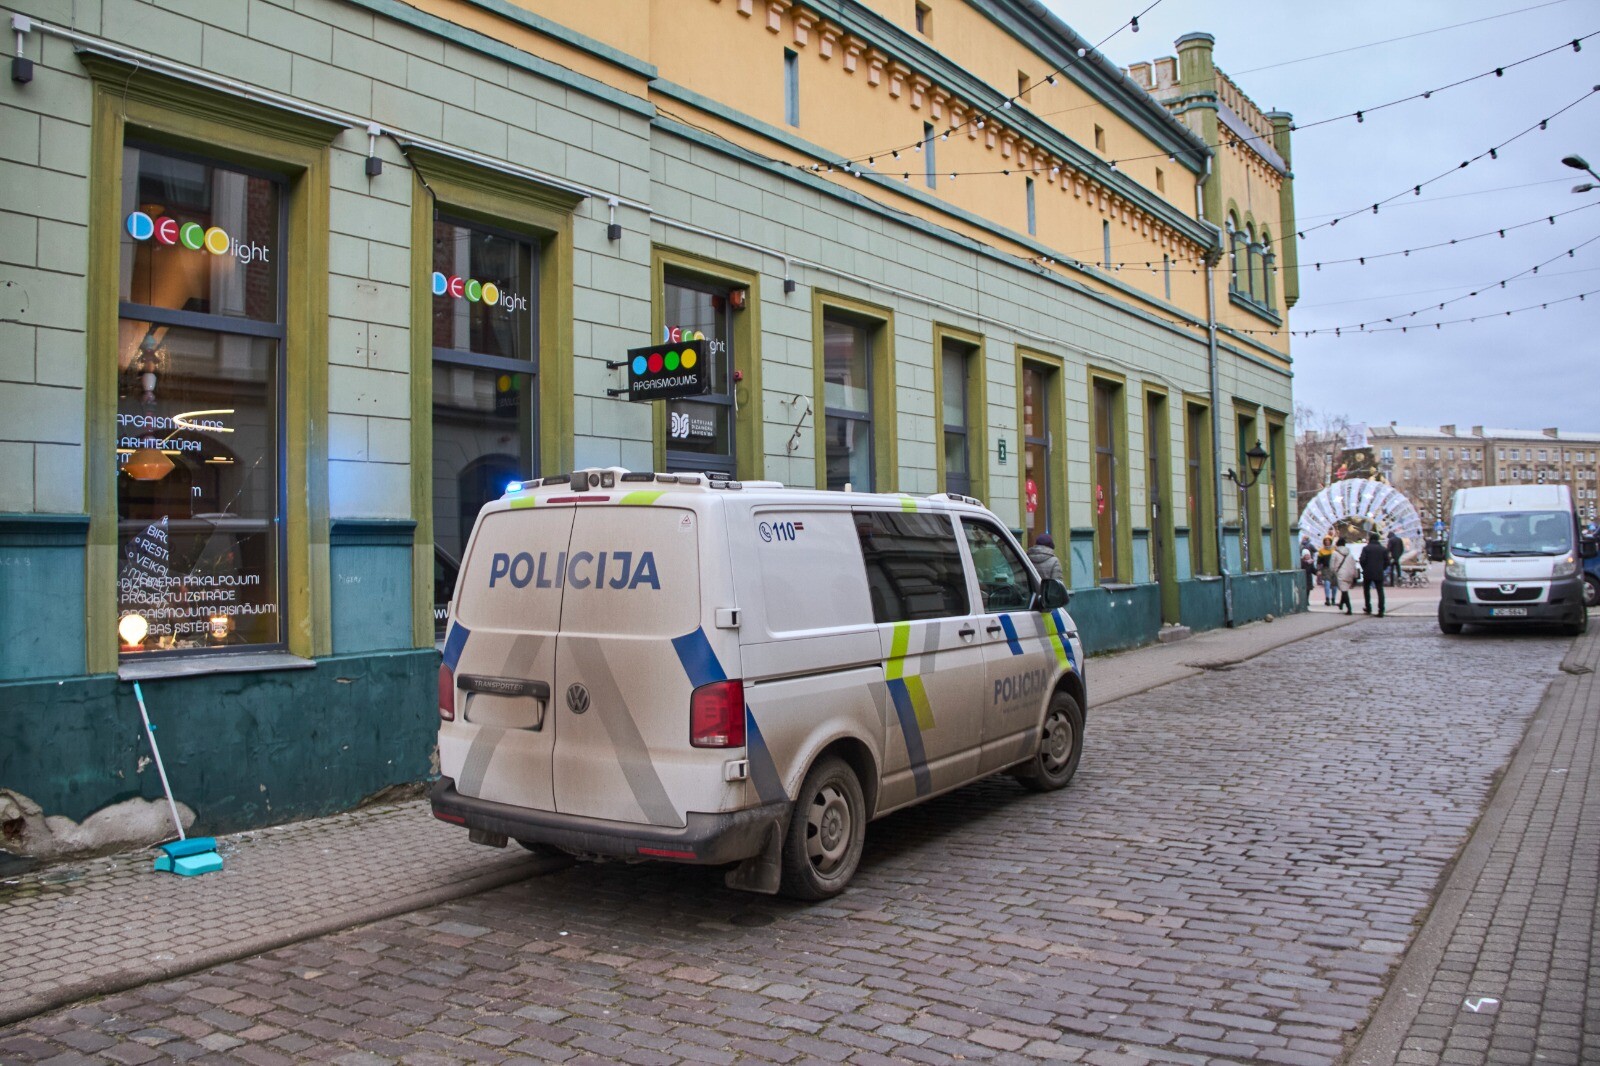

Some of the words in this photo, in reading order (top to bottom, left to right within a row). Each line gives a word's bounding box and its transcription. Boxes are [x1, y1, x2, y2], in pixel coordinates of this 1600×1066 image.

[633, 374, 698, 391] APGAISMOJUMS
[1000, 446, 1005, 458] 2
[772, 521, 796, 541] 110
[489, 550, 661, 590] POLICIJA
[183, 574, 260, 587] PAKALPOJUMI
[184, 589, 236, 602] IZSTRĀDE
[219, 603, 277, 616] RISINĀJUMI
[474, 680, 524, 691] TRANSPORTER
[993, 668, 1049, 706] POLICIJA
